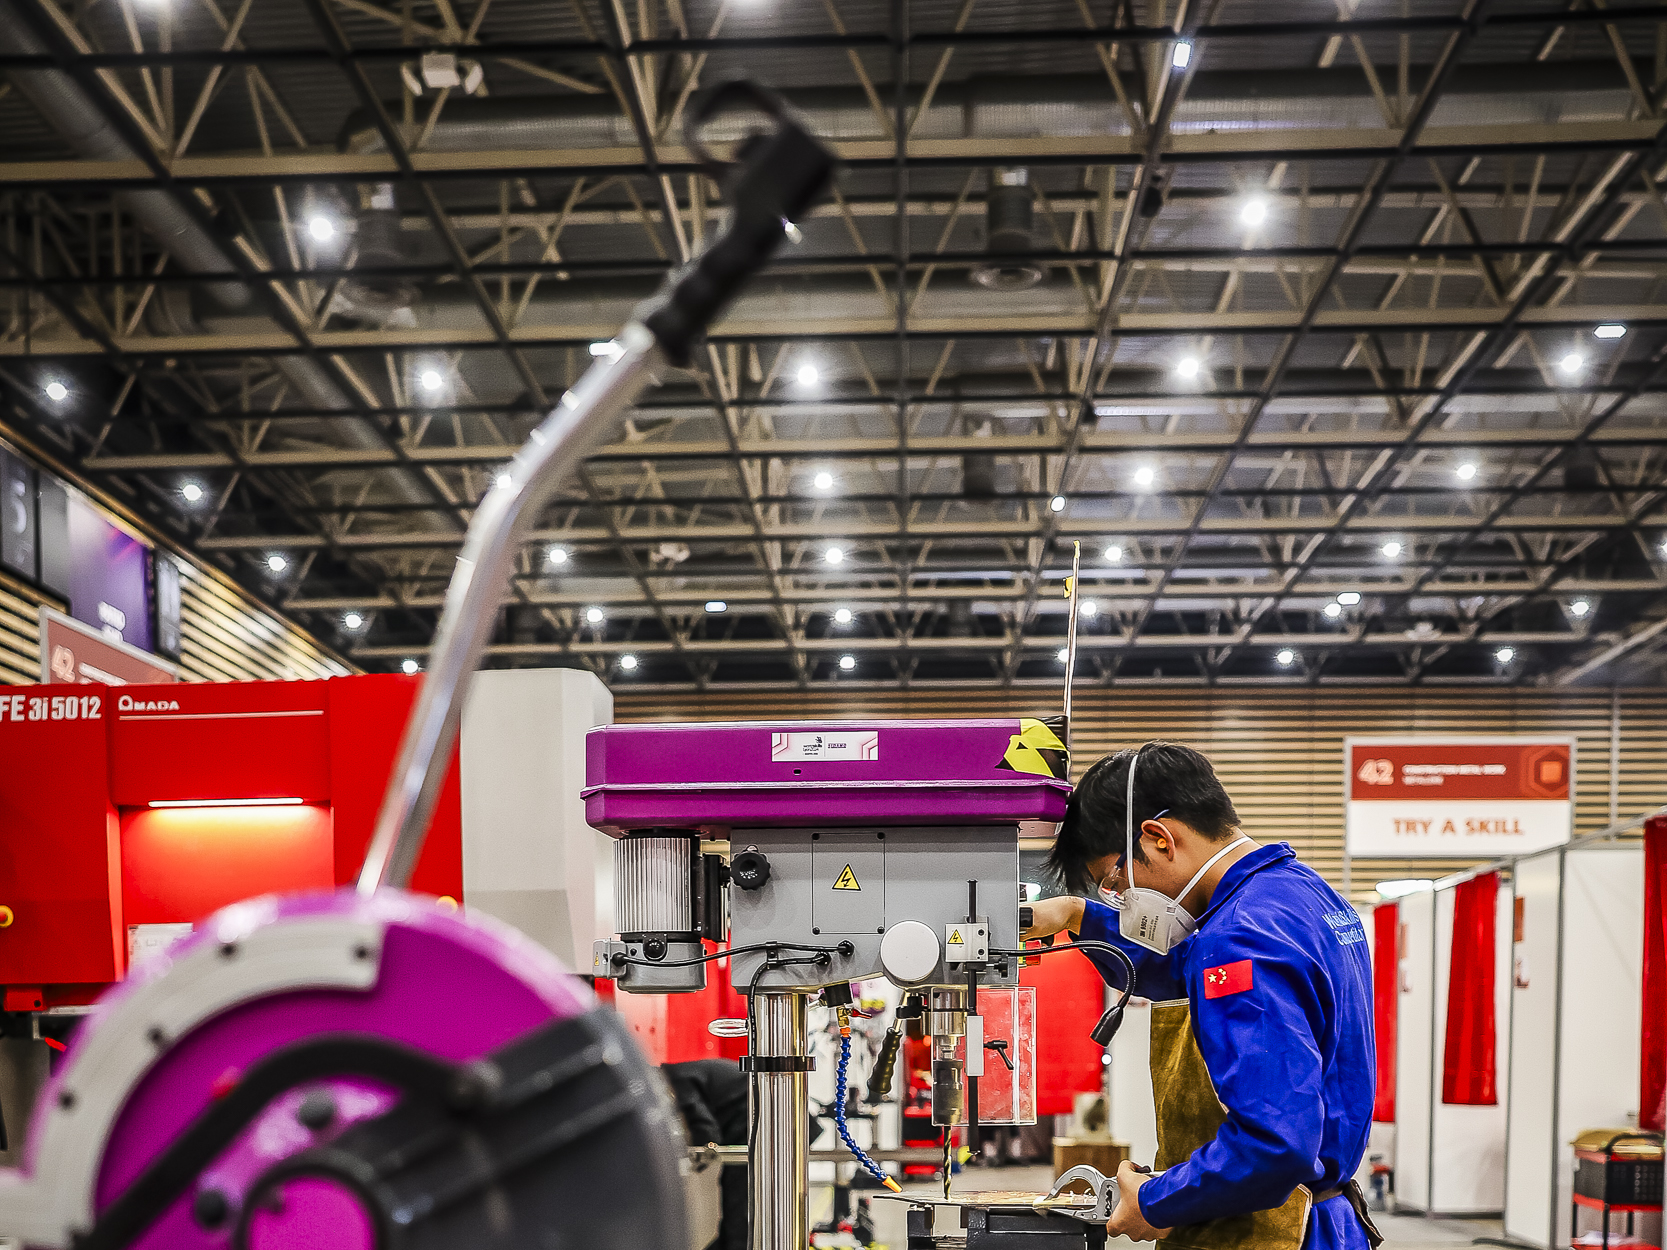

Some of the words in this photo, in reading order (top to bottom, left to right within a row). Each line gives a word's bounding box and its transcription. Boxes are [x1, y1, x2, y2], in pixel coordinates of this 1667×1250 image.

[28, 696, 49, 721] 3i
[51, 695, 102, 721] 5012
[1356, 758, 1395, 786] 42
[1393, 819, 1432, 835] TRY
[1442, 819, 1456, 835] A
[1465, 819, 1524, 836] SKILL
